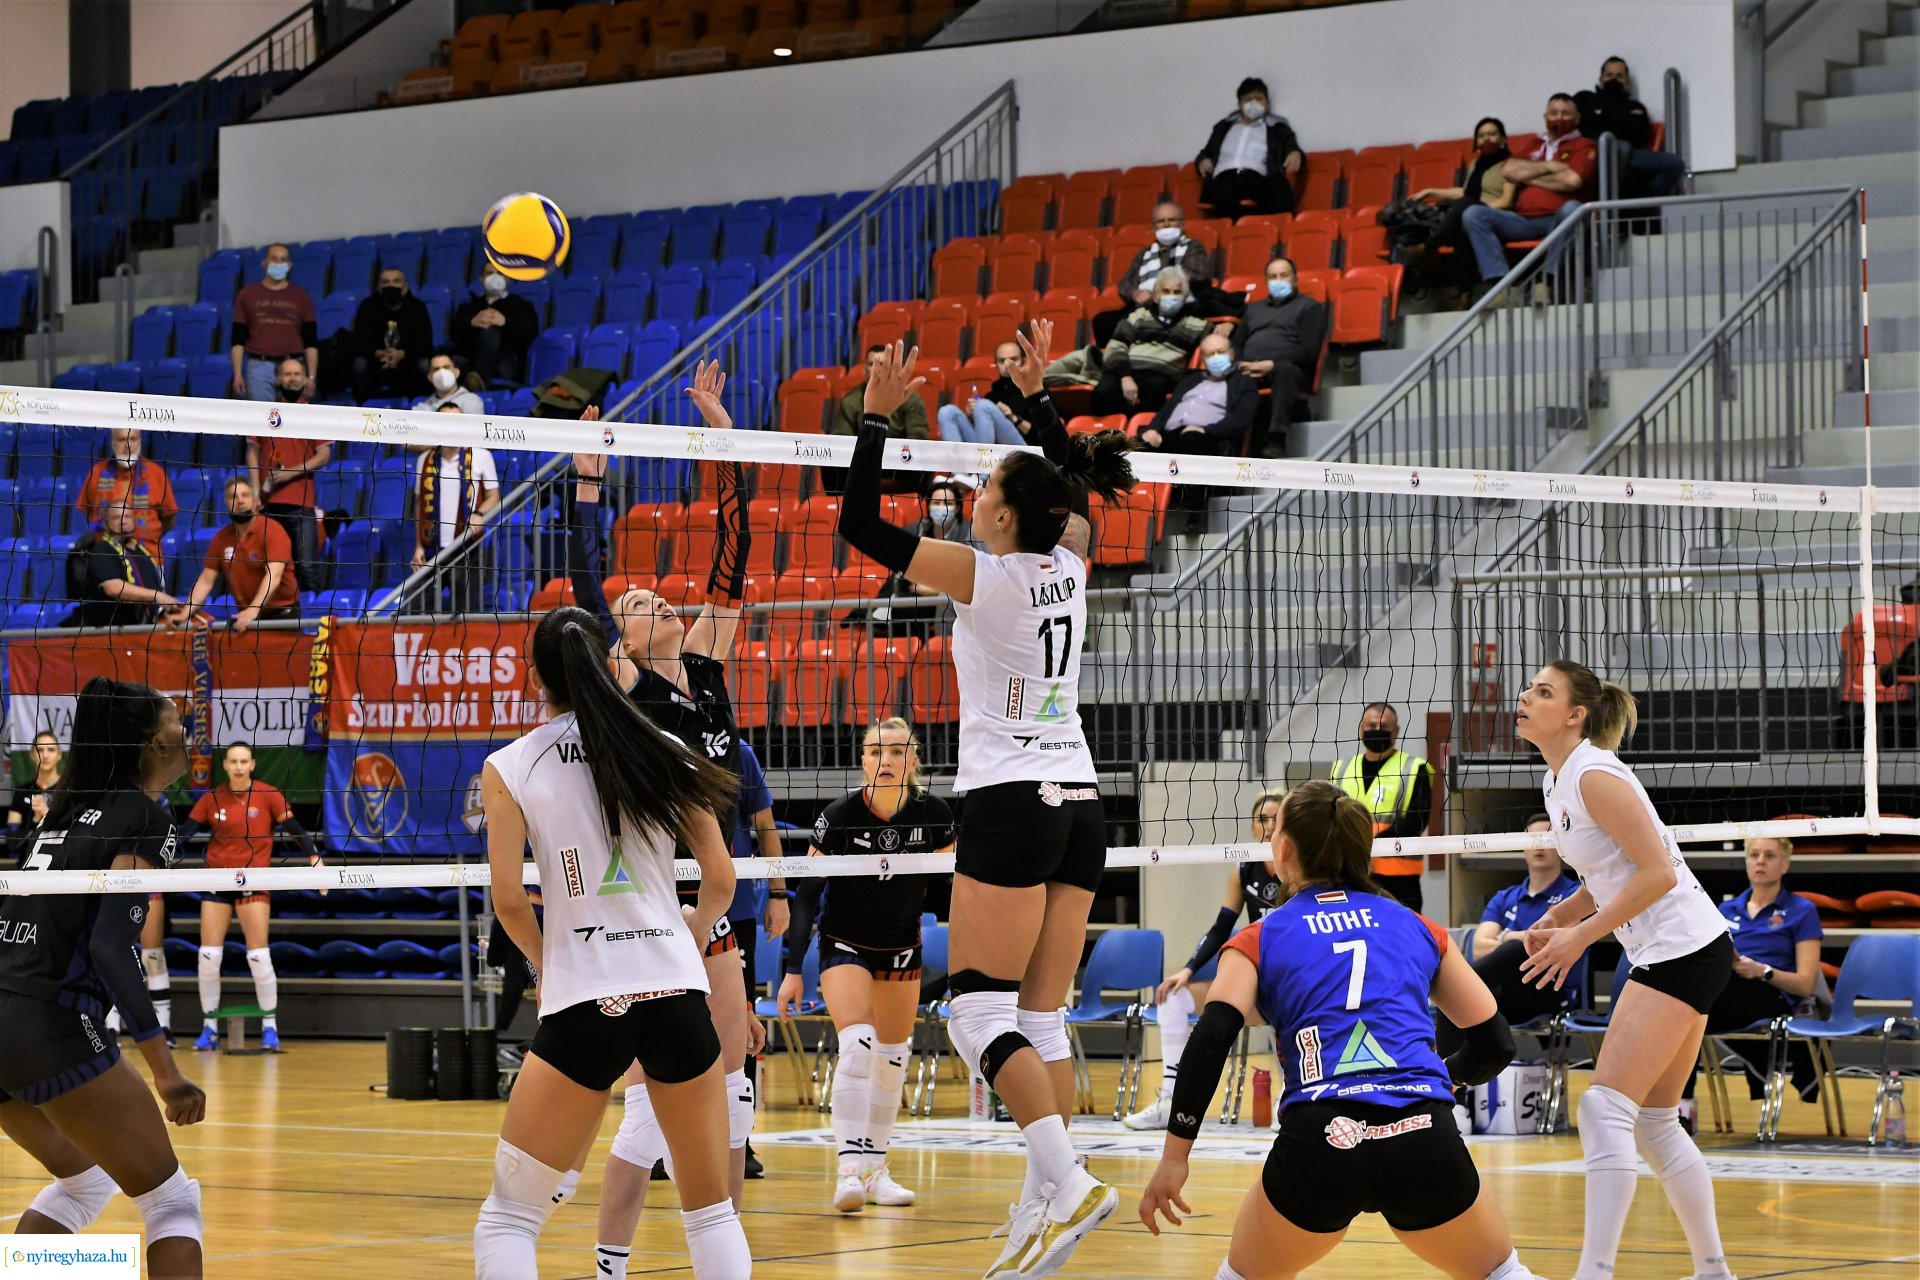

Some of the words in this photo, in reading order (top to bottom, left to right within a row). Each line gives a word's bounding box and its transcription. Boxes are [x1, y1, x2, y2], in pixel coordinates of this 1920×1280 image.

[128, 400, 175, 421] FATUM
[483, 422, 526, 442] FATUM
[794, 440, 832, 459] FATUM
[1324, 468, 1355, 485] FATUM
[1038, 615, 1072, 679] 17
[394, 633, 517, 686] Vasas
[1010, 677, 1021, 720] STRABAG
[347, 692, 480, 728] Szurkolói
[1224, 847, 1250, 860] FATUM
[1463, 838, 1487, 849] FATUM
[339, 870, 375, 885] FATUM
[565, 848, 581, 898] STRABAG
[674, 866, 701, 878] ATUM
[1303, 910, 1361, 934] TÓTH
[1359, 908, 1380, 928] F.
[606, 929, 674, 942] BESTRONG
[892, 949, 914, 969] 17
[1333, 939, 1367, 1010] 7
[1303, 1030, 1317, 1080] STRABAG
[1364, 1115, 1432, 1138] REVESZ
